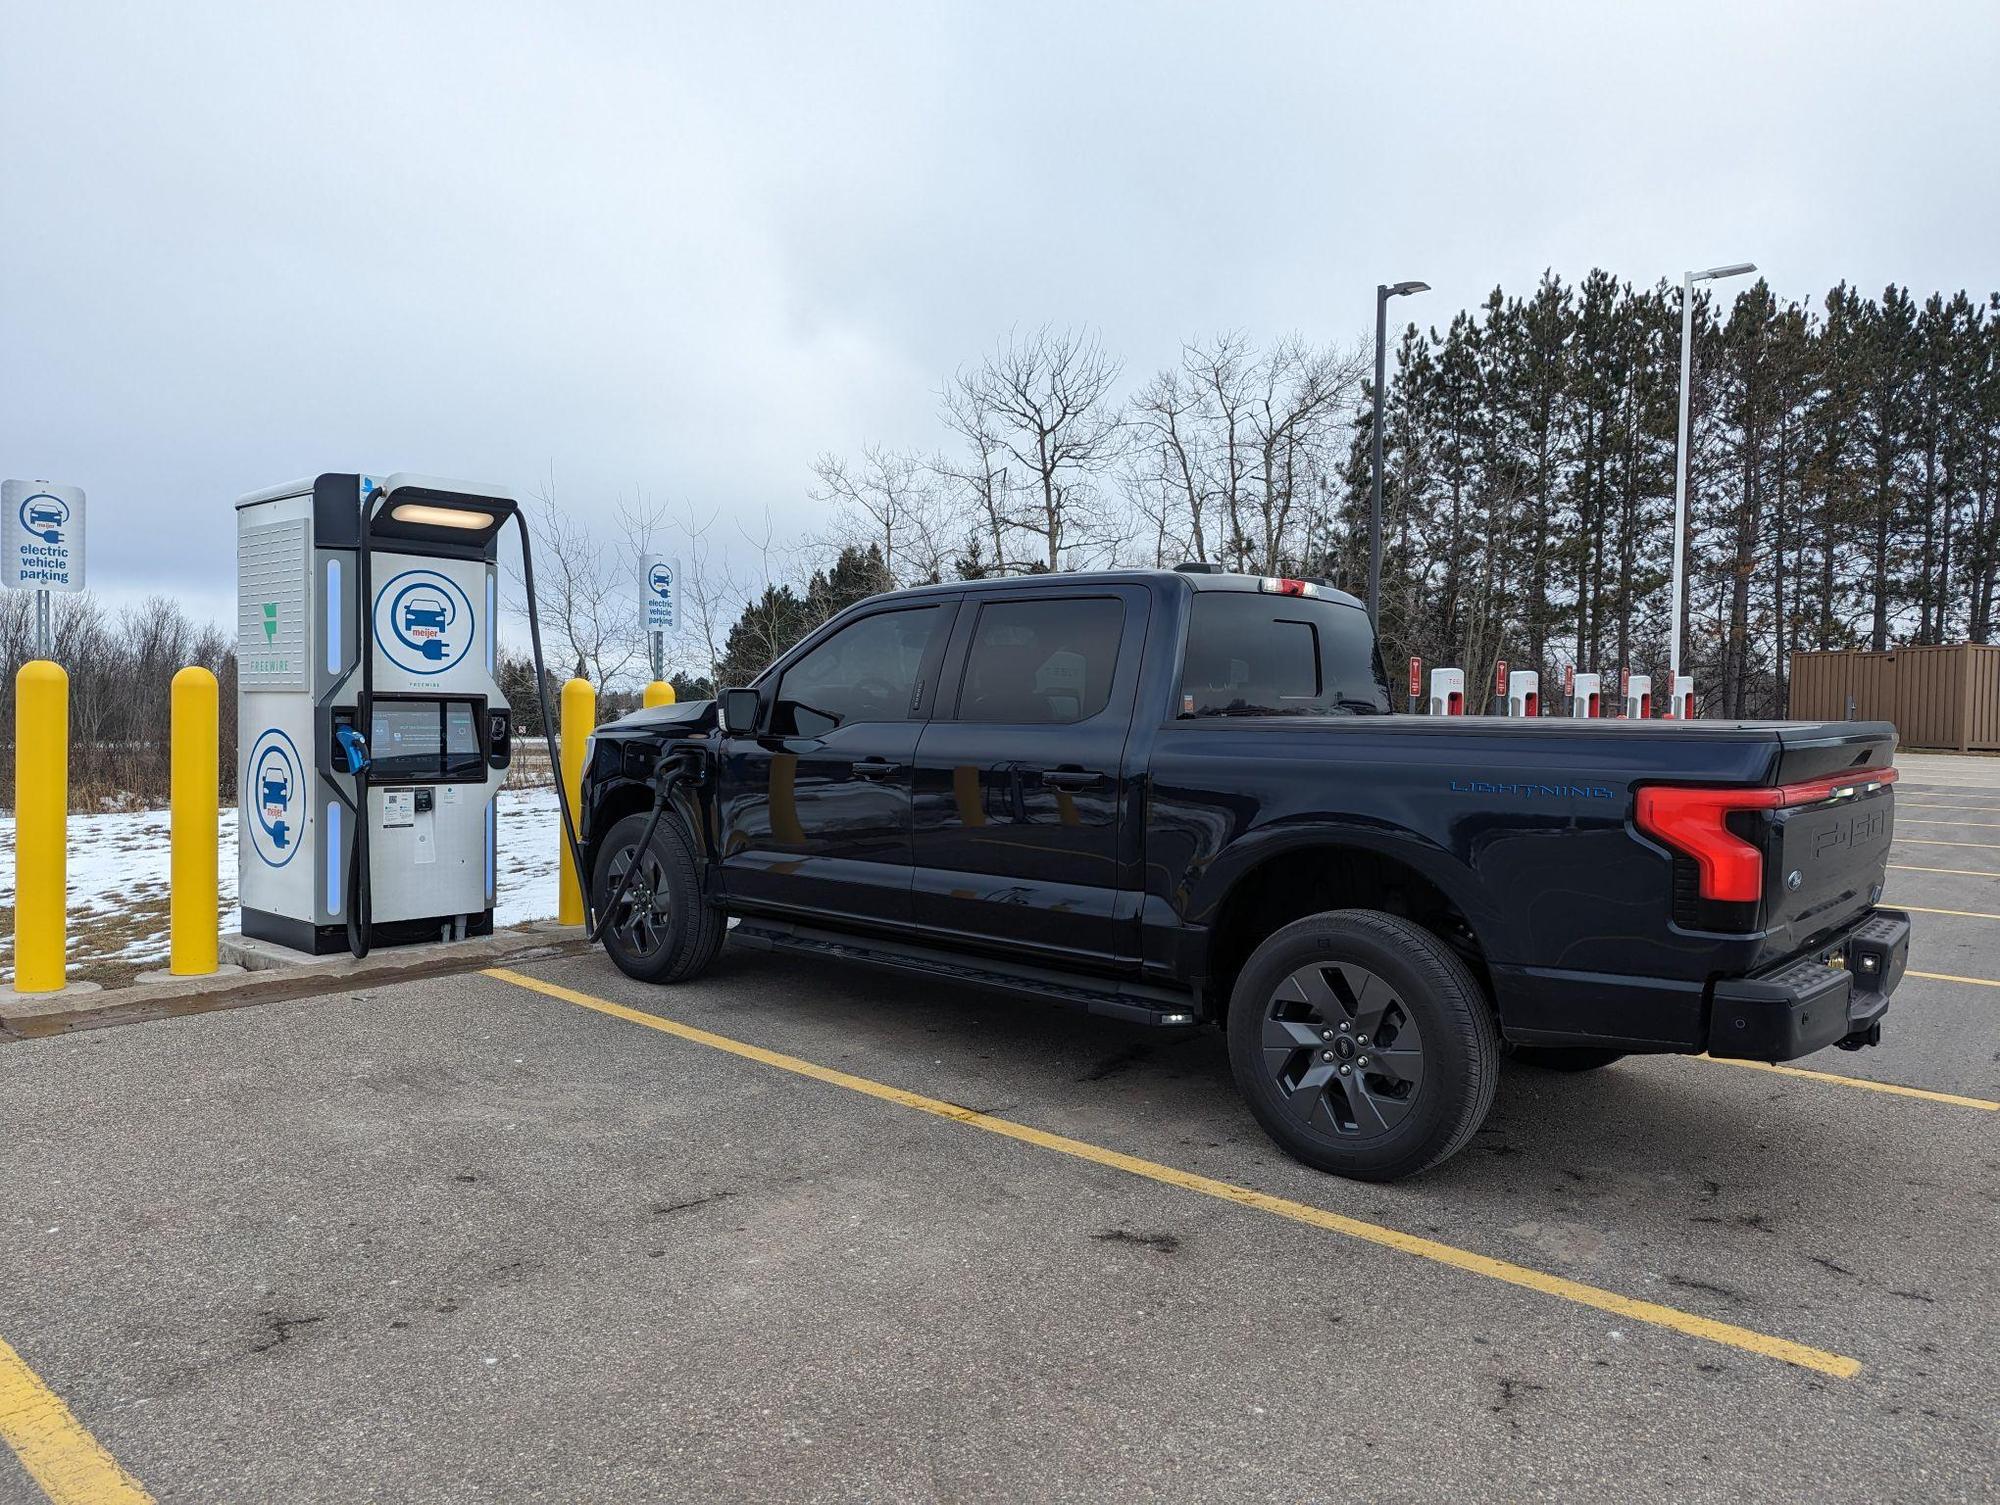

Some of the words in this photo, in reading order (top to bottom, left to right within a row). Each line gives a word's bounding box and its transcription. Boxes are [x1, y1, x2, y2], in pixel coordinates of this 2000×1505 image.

[20, 544, 69, 558] electric
[22, 557, 67, 570] vehicle
[20, 569, 69, 584] parking
[648, 598, 673, 608] electric
[649, 607, 672, 617] vehicle
[648, 617, 673, 627] parking
[412, 628, 438, 638] meijer
[1450, 781, 1615, 799] LIGHTNING
